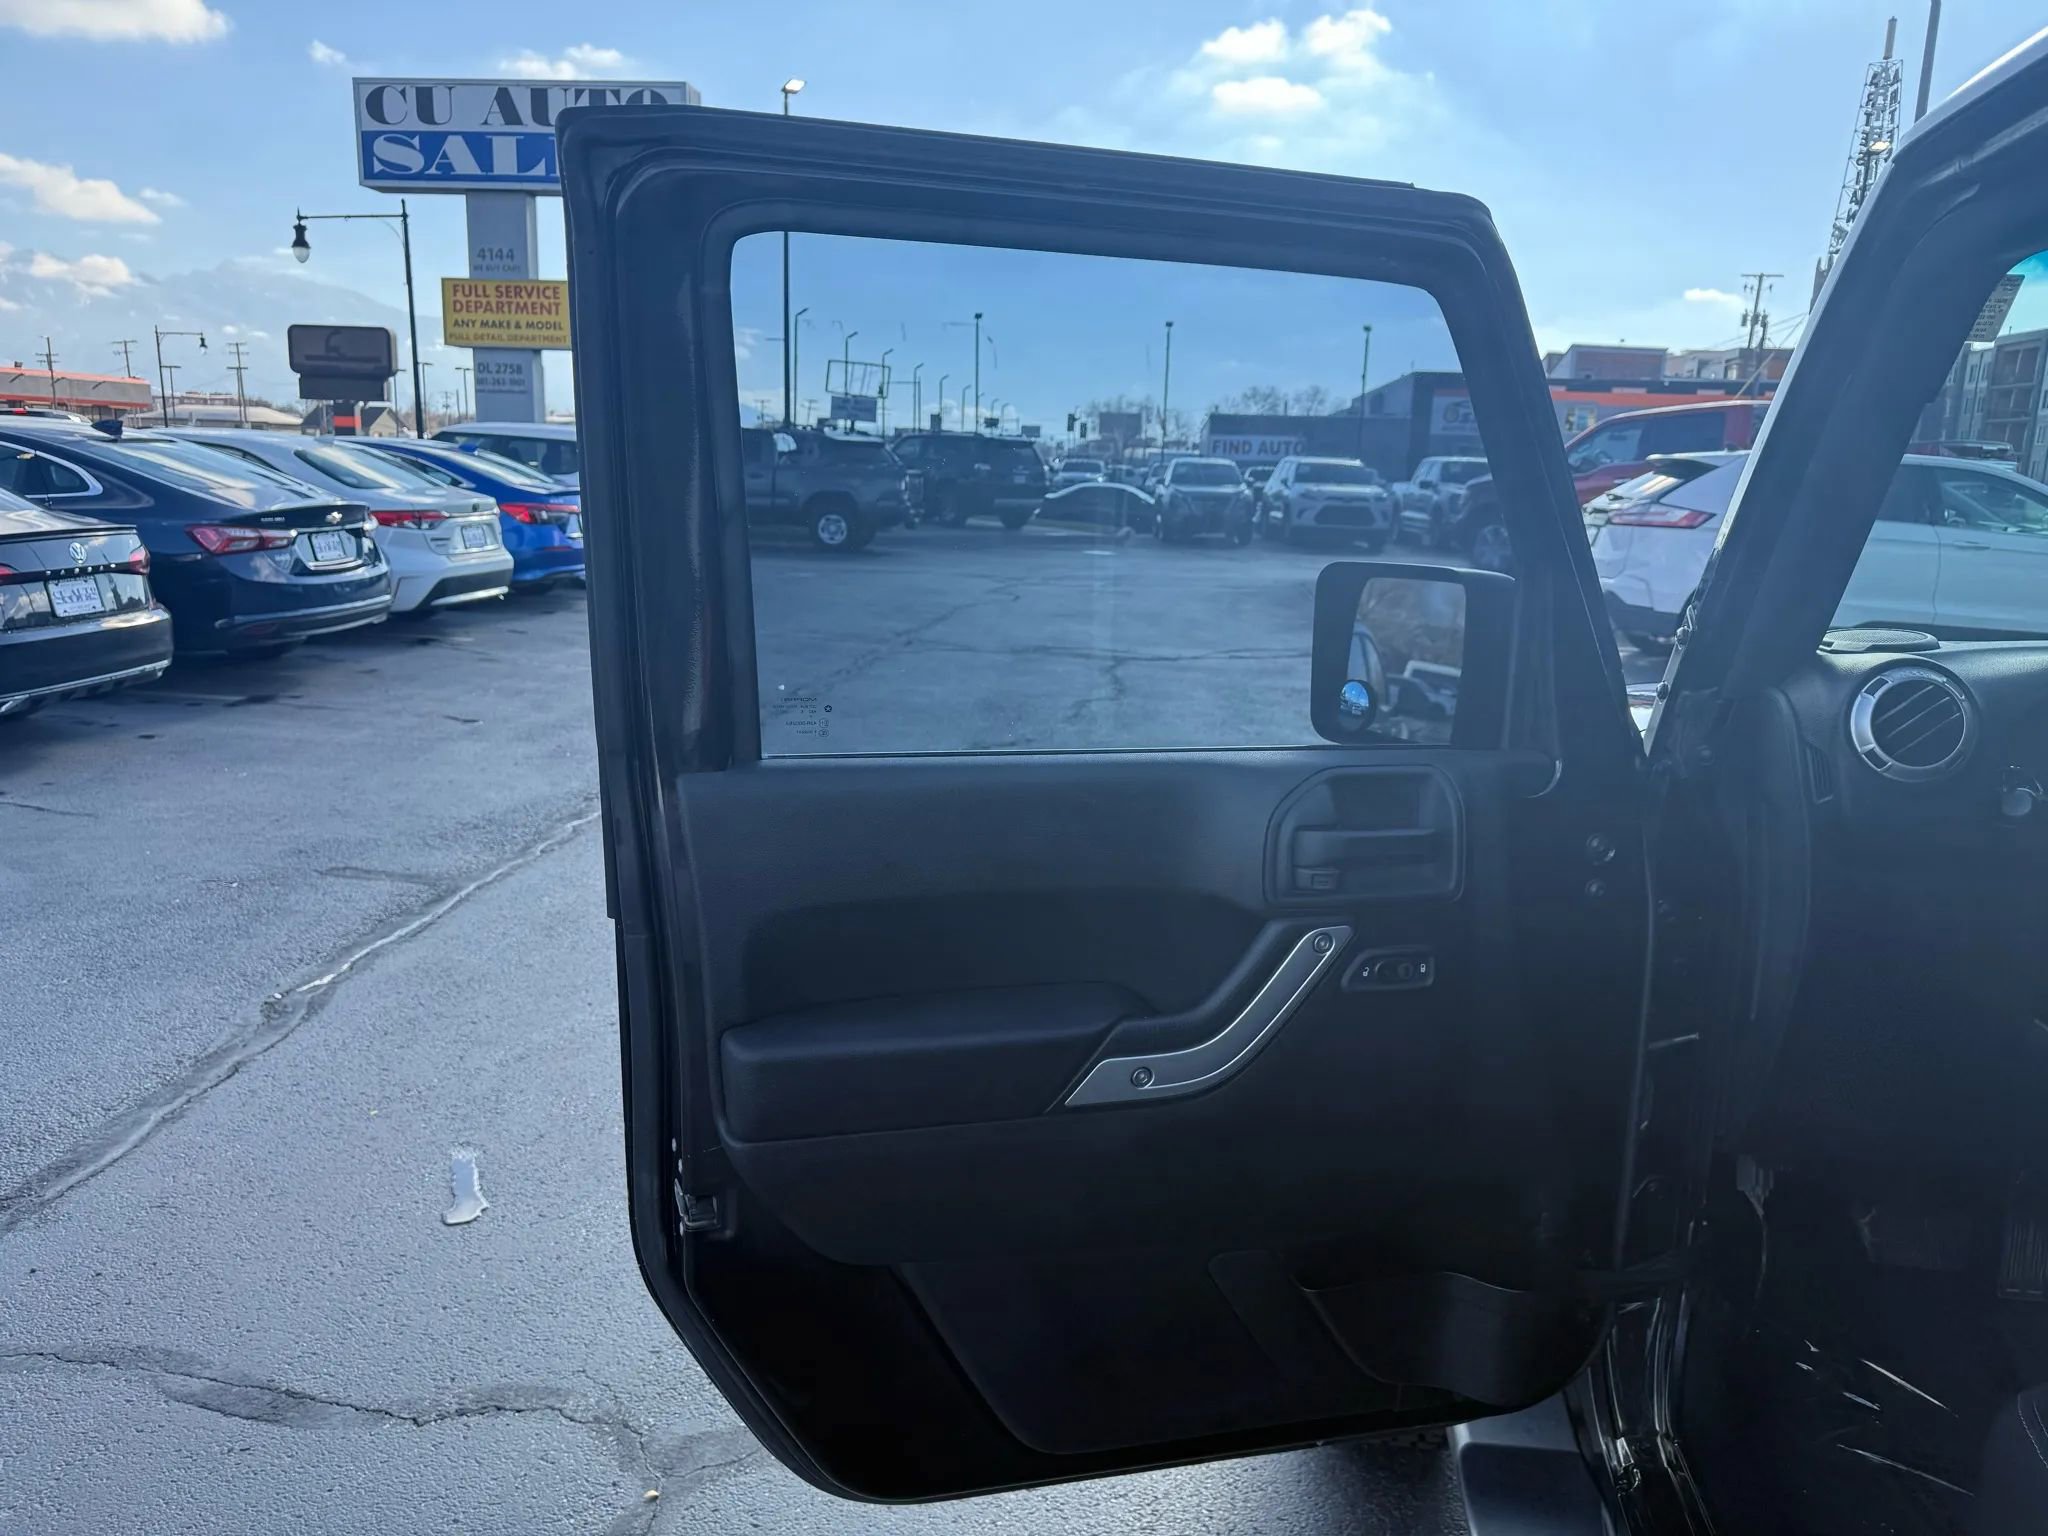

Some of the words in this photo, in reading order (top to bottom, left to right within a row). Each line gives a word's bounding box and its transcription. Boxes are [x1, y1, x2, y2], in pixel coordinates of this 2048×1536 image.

[365, 84, 456, 127] CU
[372, 133, 560, 176] SAL
[476, 247, 515, 262] 4144
[452, 284, 491, 299] FULL
[495, 285, 561, 300] SERVICE
[452, 300, 562, 316] DEPARTMENT
[453, 319, 477, 330] ANY
[480, 319, 511, 330] MAKE
[514, 321, 522, 330] &
[526, 321, 564, 331] MODEL
[473, 333, 504, 342] DETAIL
[507, 334, 568, 344] DEPARTMENT
[477, 362, 493, 374] DL
[1212, 439, 1252, 456] FIND
[1256, 439, 1305, 456] AUTO
